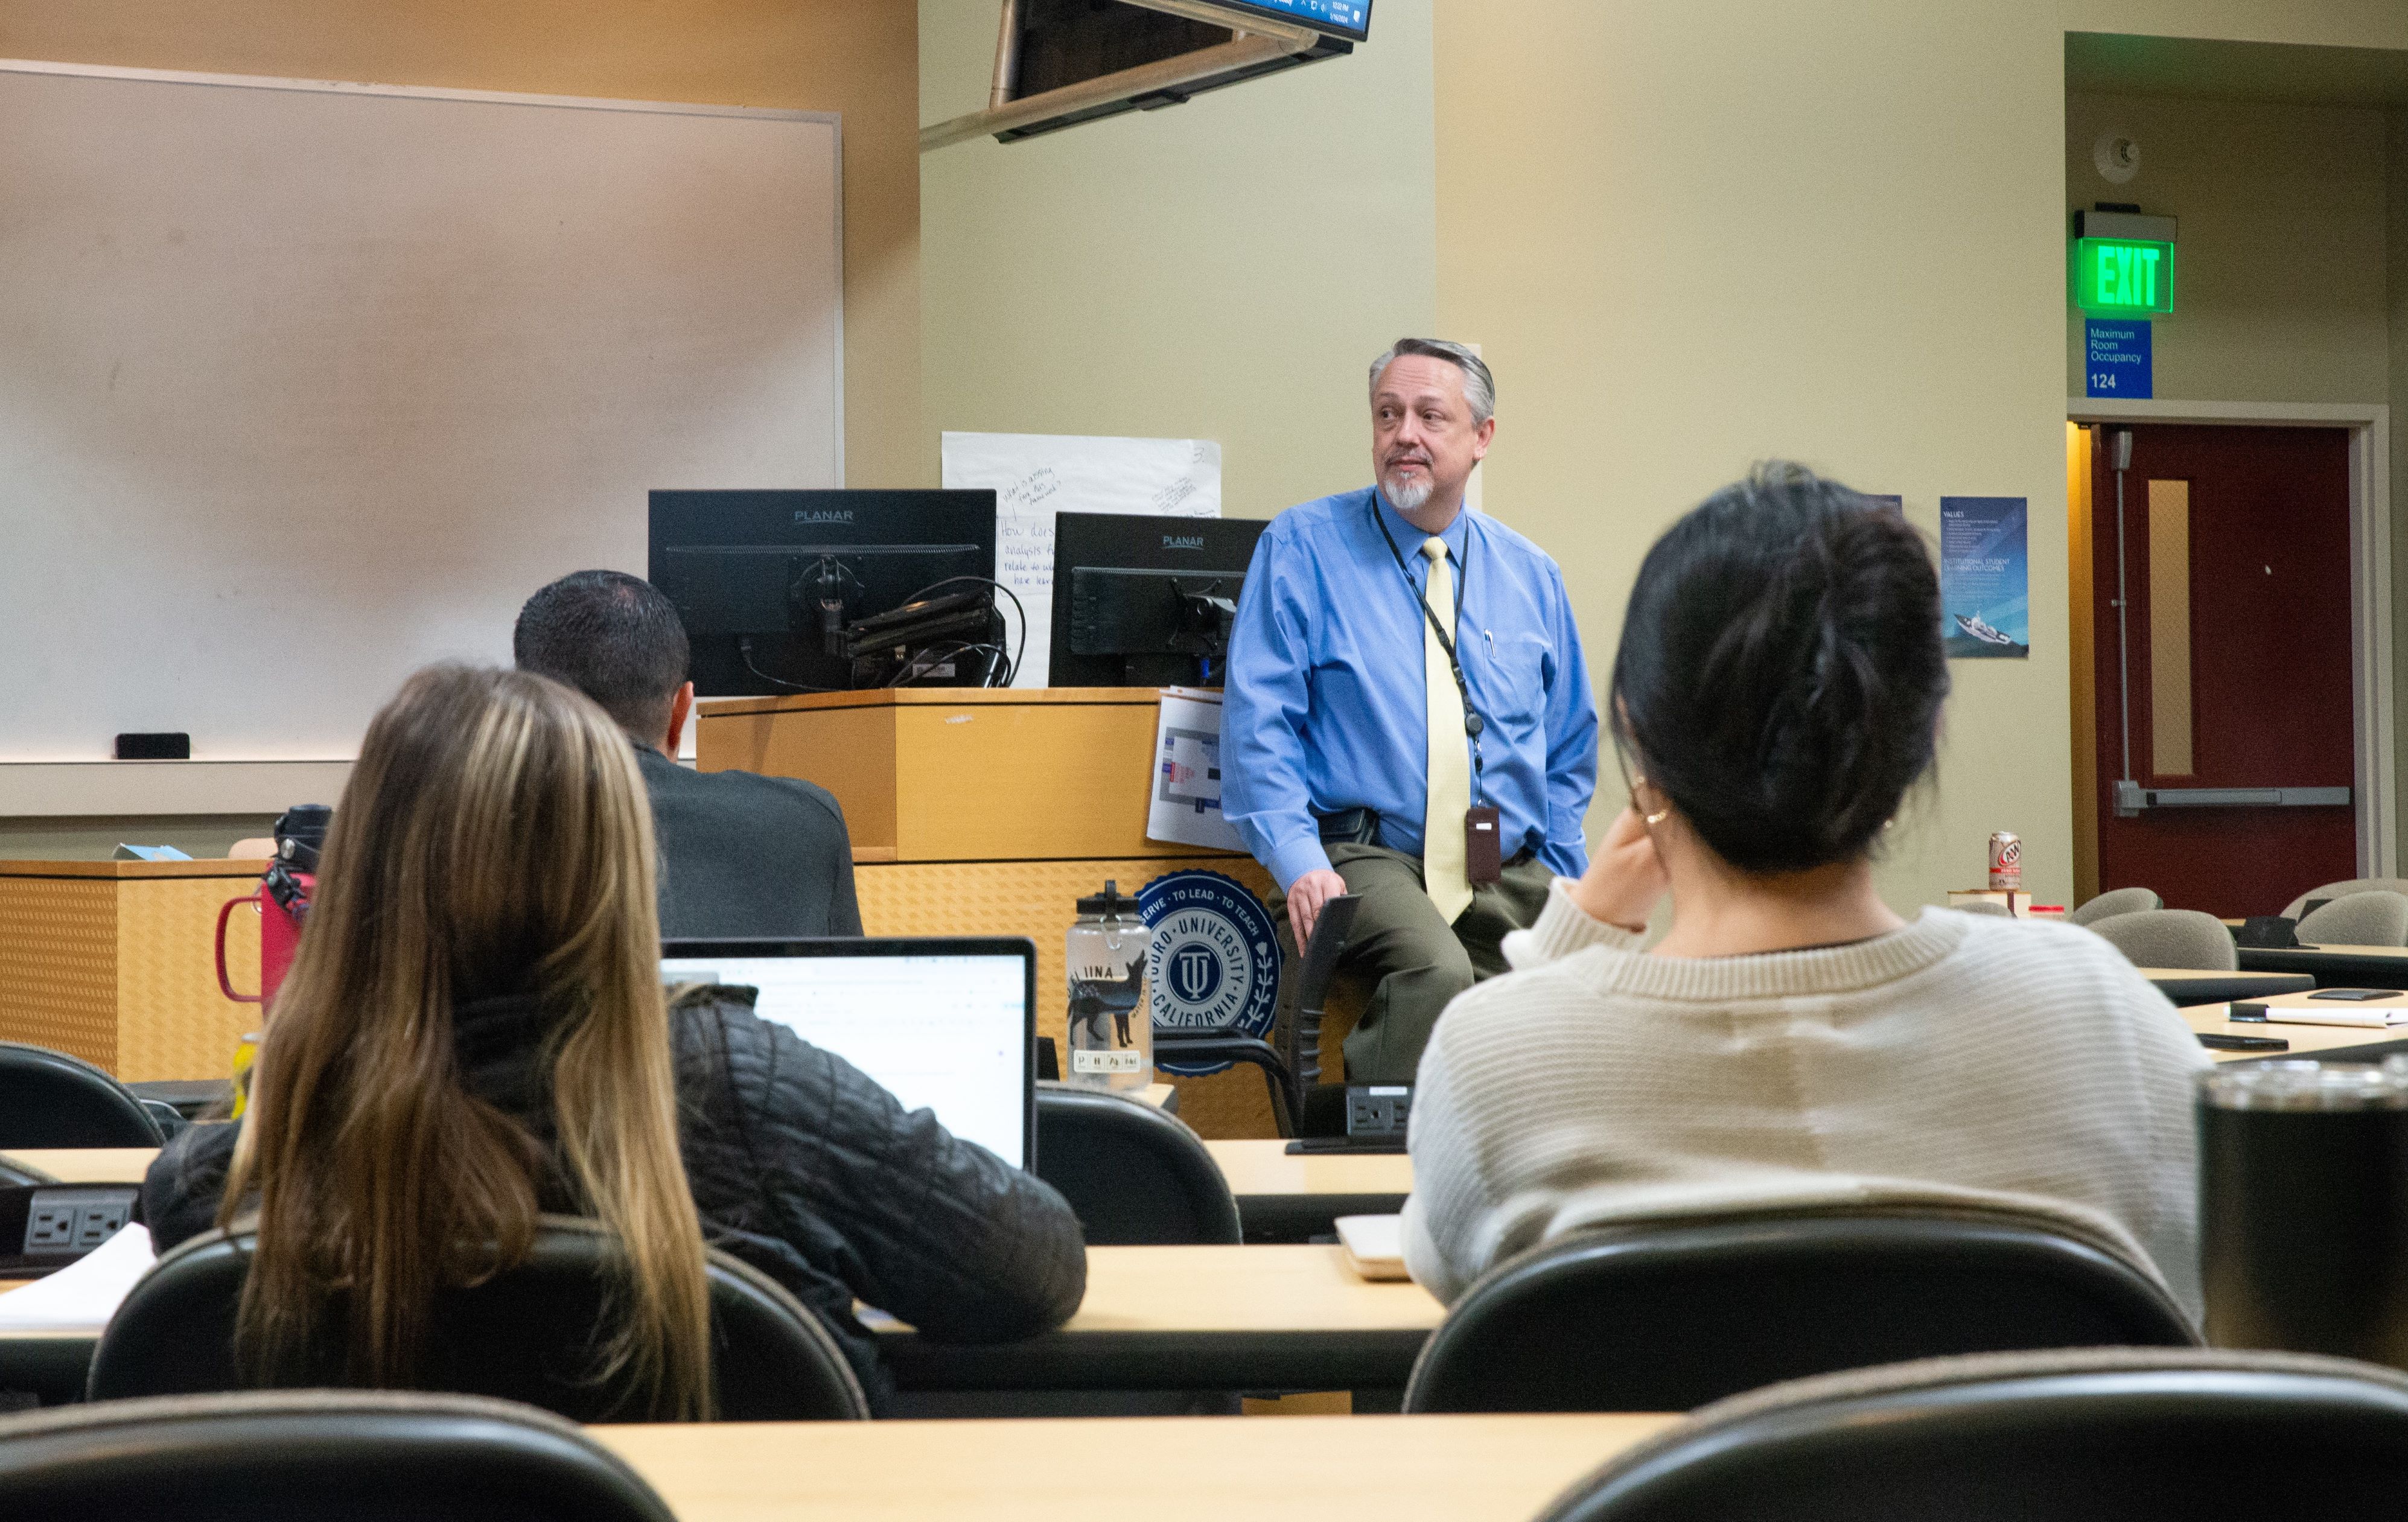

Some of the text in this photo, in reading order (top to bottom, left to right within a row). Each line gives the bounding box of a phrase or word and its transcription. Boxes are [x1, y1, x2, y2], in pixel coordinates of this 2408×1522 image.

[1342, 3, 1349, 12] PM
[2097, 245, 2159, 306] EXIT
[2091, 328, 2135, 339] Maximum
[2091, 340, 2118, 350] Room
[2091, 351, 2141, 365] Occupancy
[2091, 373, 2116, 389] 124
[794, 511, 854, 520] PLANAR
[1001, 520, 1054, 537] How does
[1162, 535, 1204, 547] PLANAR
[1005, 544, 1041, 560] analysis
[1004, 559, 1027, 572] relate
[1030, 561, 1039, 571] to
[1014, 574, 1054, 585] have lear
[1138, 888, 1259, 937] SERVE TO LEAD TO TEACH
[1179, 917, 1244, 984] UNIVERSITY
[1153, 993, 1238, 1027] CALIFORNIA
